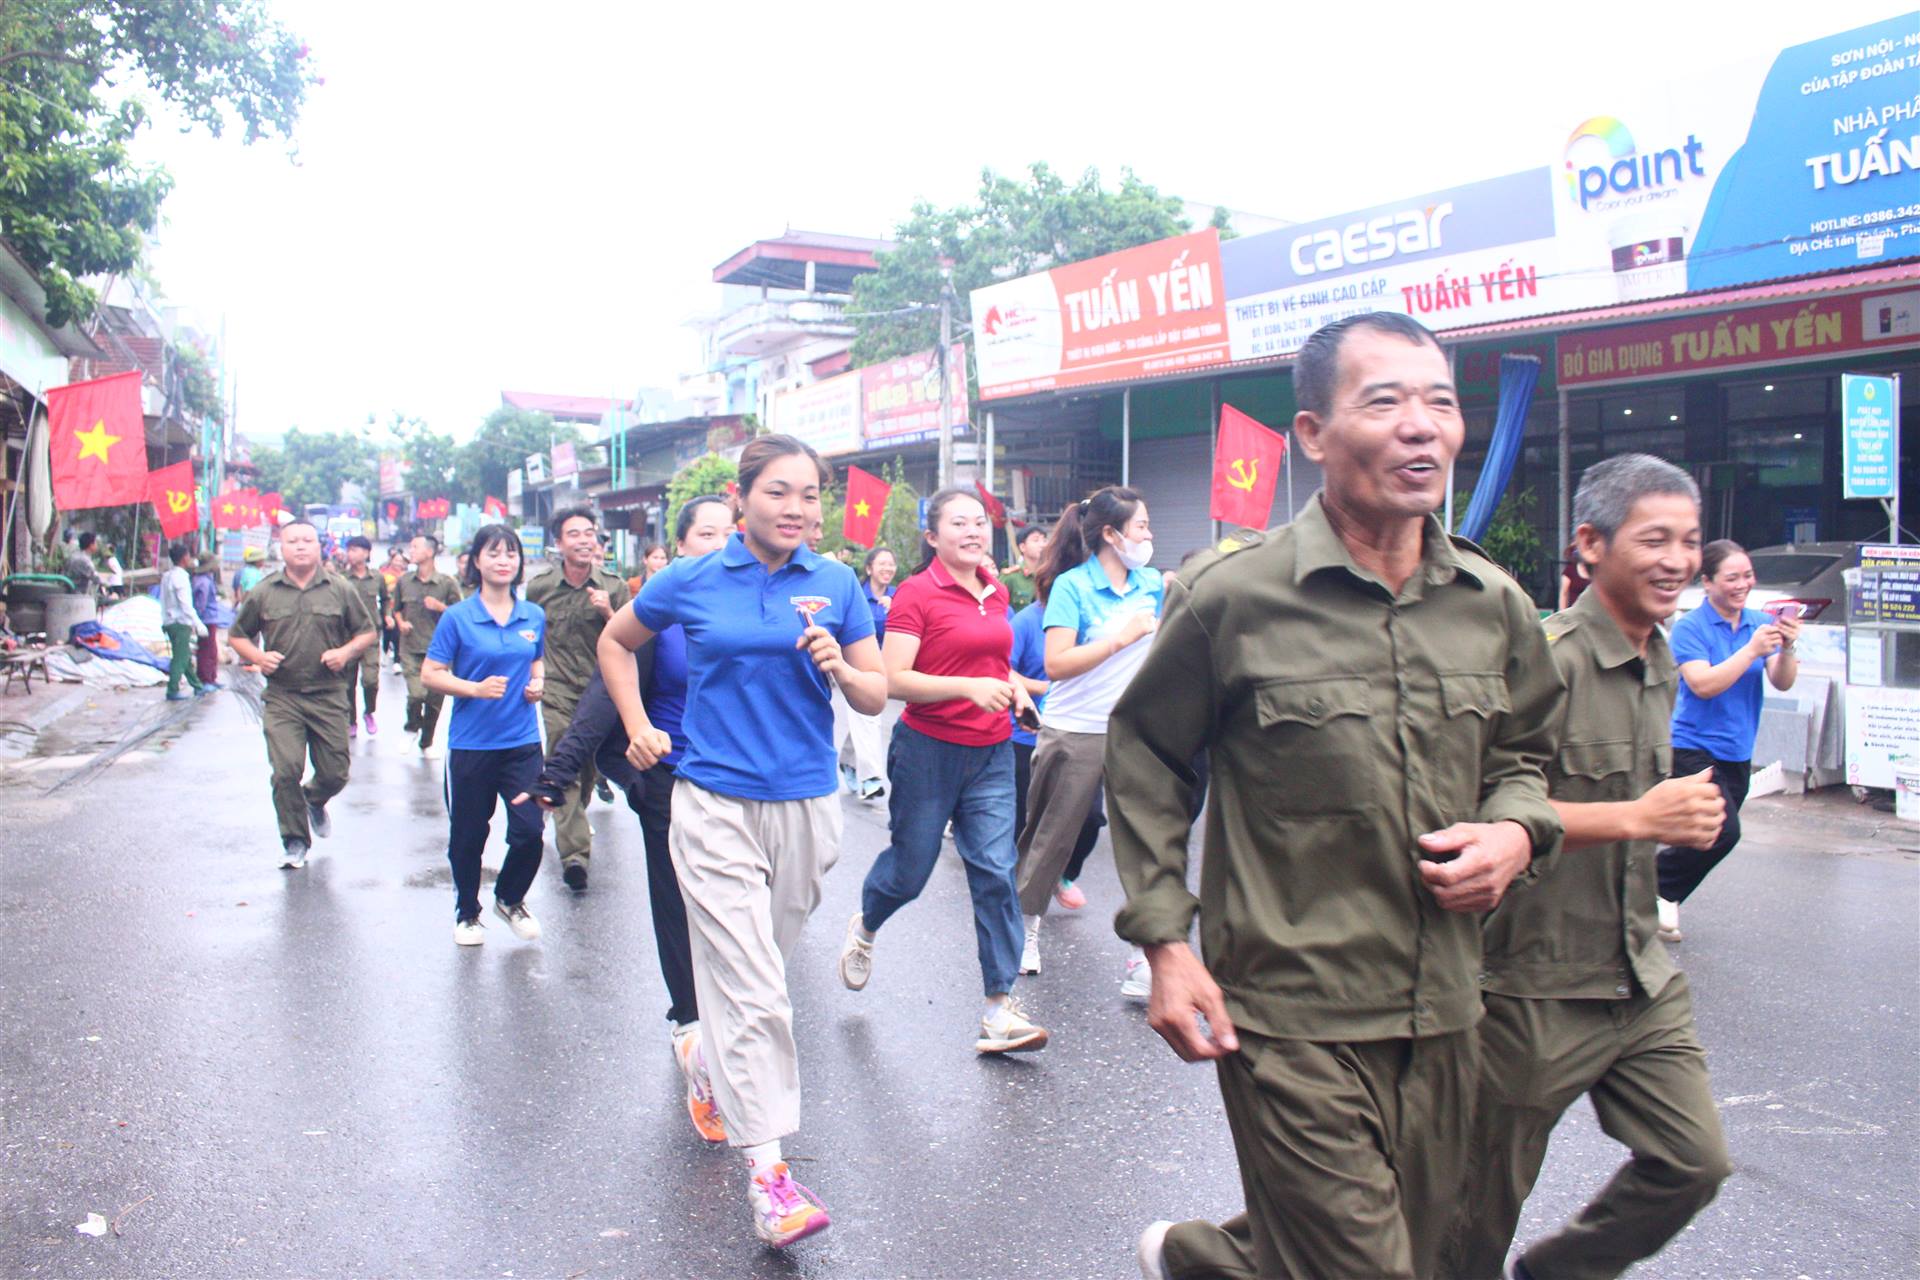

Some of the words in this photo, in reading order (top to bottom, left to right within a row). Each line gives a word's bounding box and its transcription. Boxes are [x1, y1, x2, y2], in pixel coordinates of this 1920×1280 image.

[1866, 38, 1894, 58] NỘI
[1830, 69, 1858, 88] TẬP
[1860, 57, 1905, 80] ĐOÀN
[1833, 105, 1880, 135] NHÀ
[1806, 127, 1920, 190] TUẤN
[1811, 214, 1862, 233] HOTLINE:
[1063, 268, 1142, 334] TUẤN
[1147, 249, 1215, 317] YẾN
[1400, 267, 1472, 317] TUẤN
[1480, 257, 1538, 304] YẾN
[1588, 347, 1615, 375] GIA
[1618, 340, 1663, 375] DỤNG
[1670, 316, 1762, 363] TUẤN
[1770, 303, 1843, 351] YẾN
